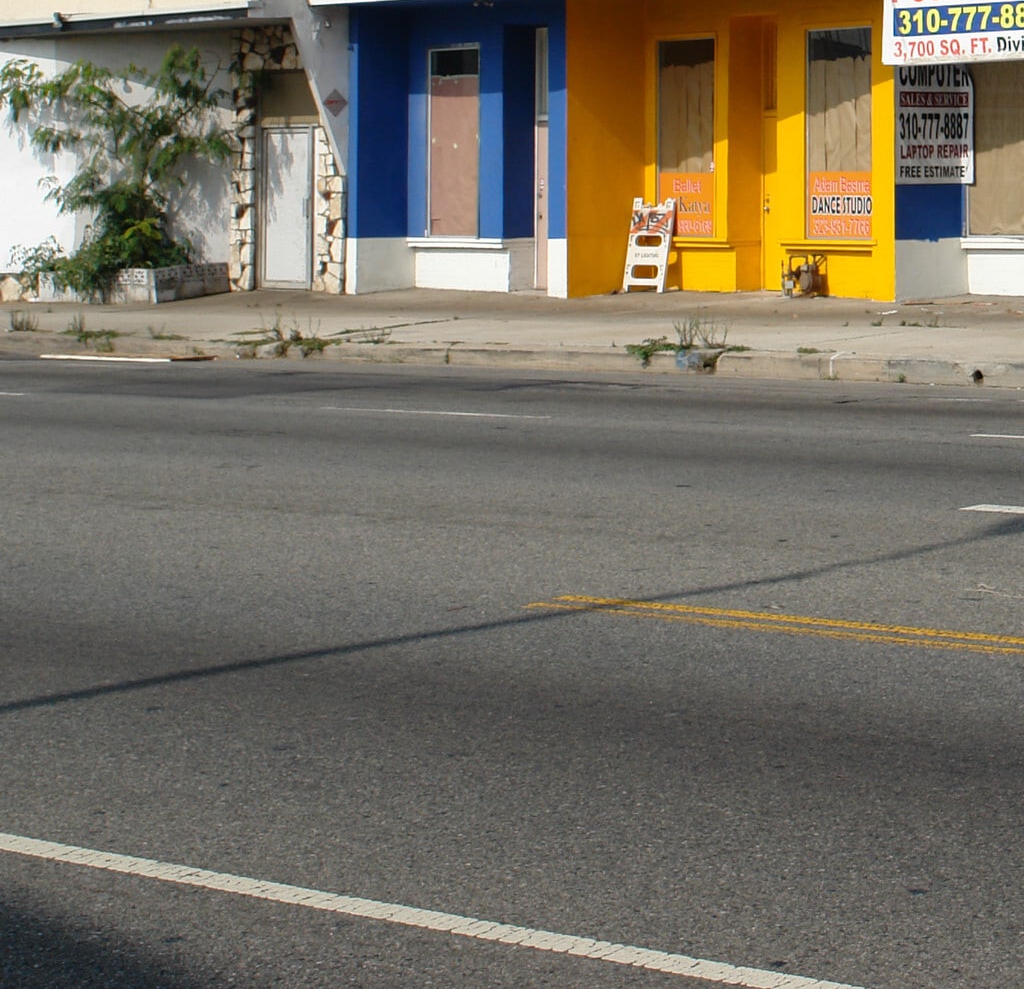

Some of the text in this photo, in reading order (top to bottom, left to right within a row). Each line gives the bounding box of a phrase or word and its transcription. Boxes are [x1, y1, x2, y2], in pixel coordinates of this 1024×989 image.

[894, 39, 935, 62] 3,700
[940, 38, 965, 56] SQ.
[970, 37, 992, 54] FT.
[899, 64, 969, 87] COMPUTER
[900, 93, 968, 106] SALES & SERVICE
[899, 113, 969, 140] 310-777-8887
[901, 144, 968, 159] LAPTOP REPAIR
[900, 166, 921, 178] FREE
[673, 178, 702, 193] Ballet
[812, 196, 873, 215] DANCE STUDIO
